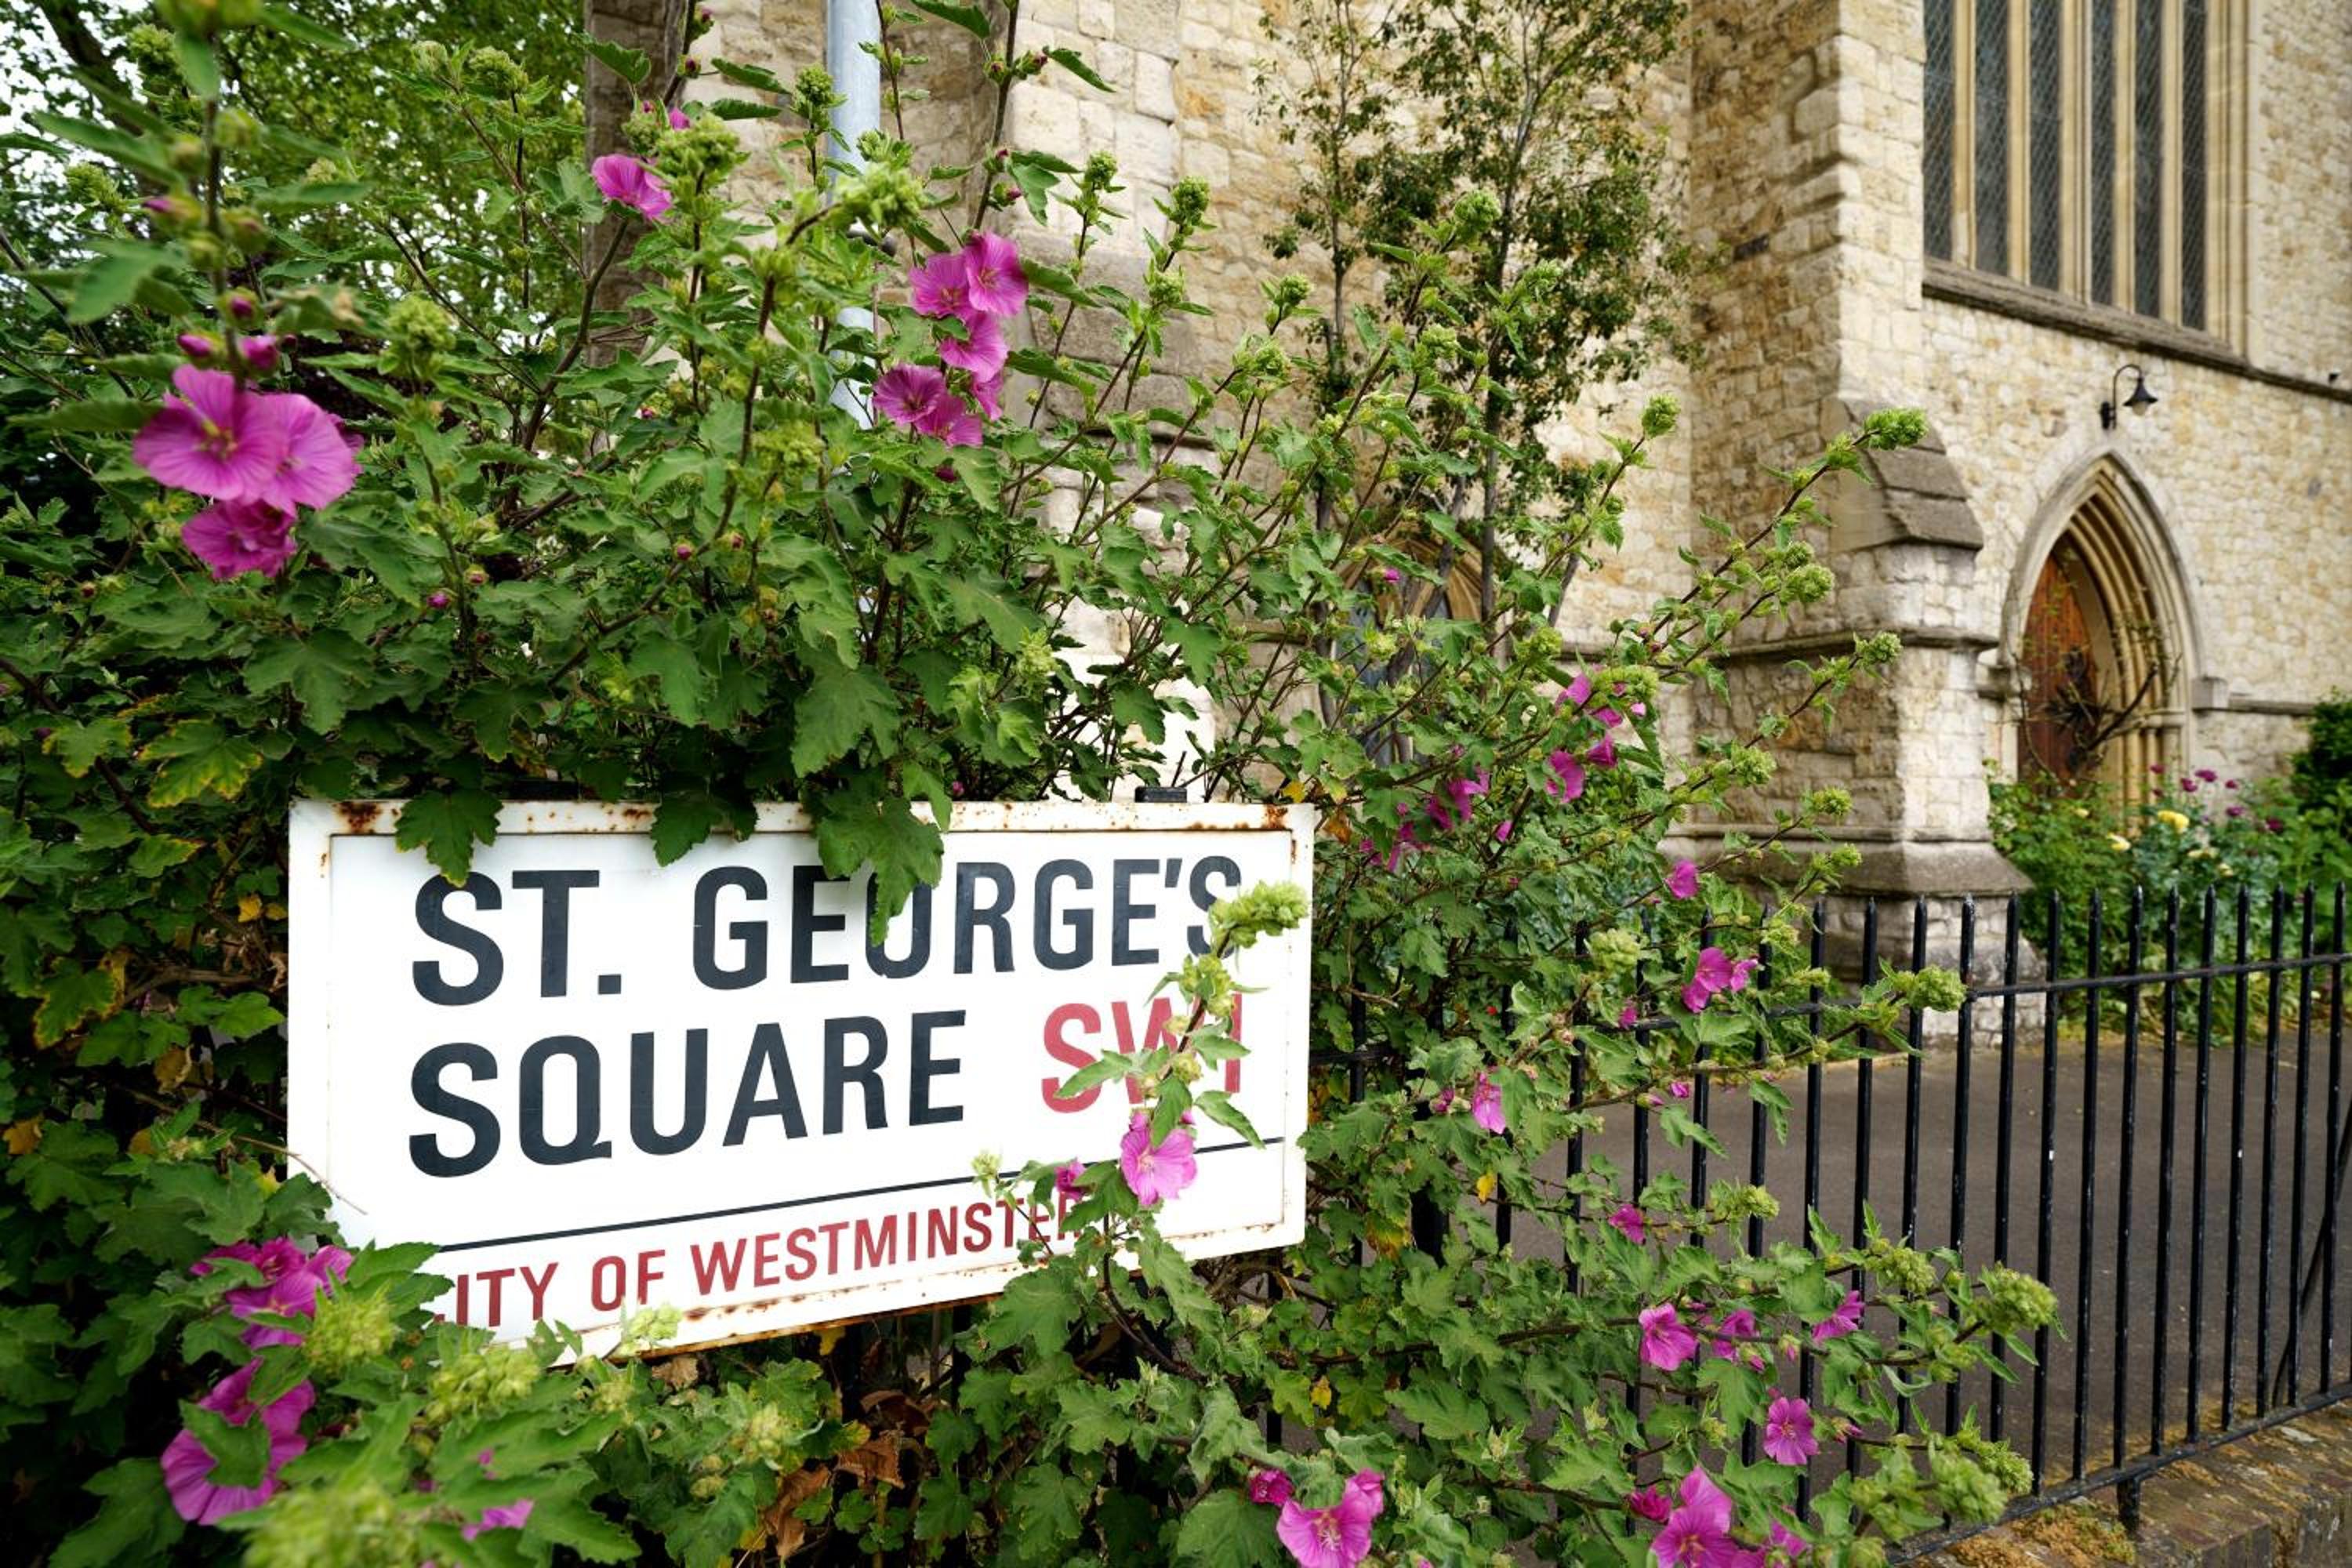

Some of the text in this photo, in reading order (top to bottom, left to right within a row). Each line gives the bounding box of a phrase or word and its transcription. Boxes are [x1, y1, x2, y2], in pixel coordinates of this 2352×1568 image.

[412, 855, 1243, 1007] ST. GEORGE'S
[408, 1009, 967, 1178] SQUARE
[431, 1261, 559, 1327] ITY
[590, 1249, 666, 1312] OF
